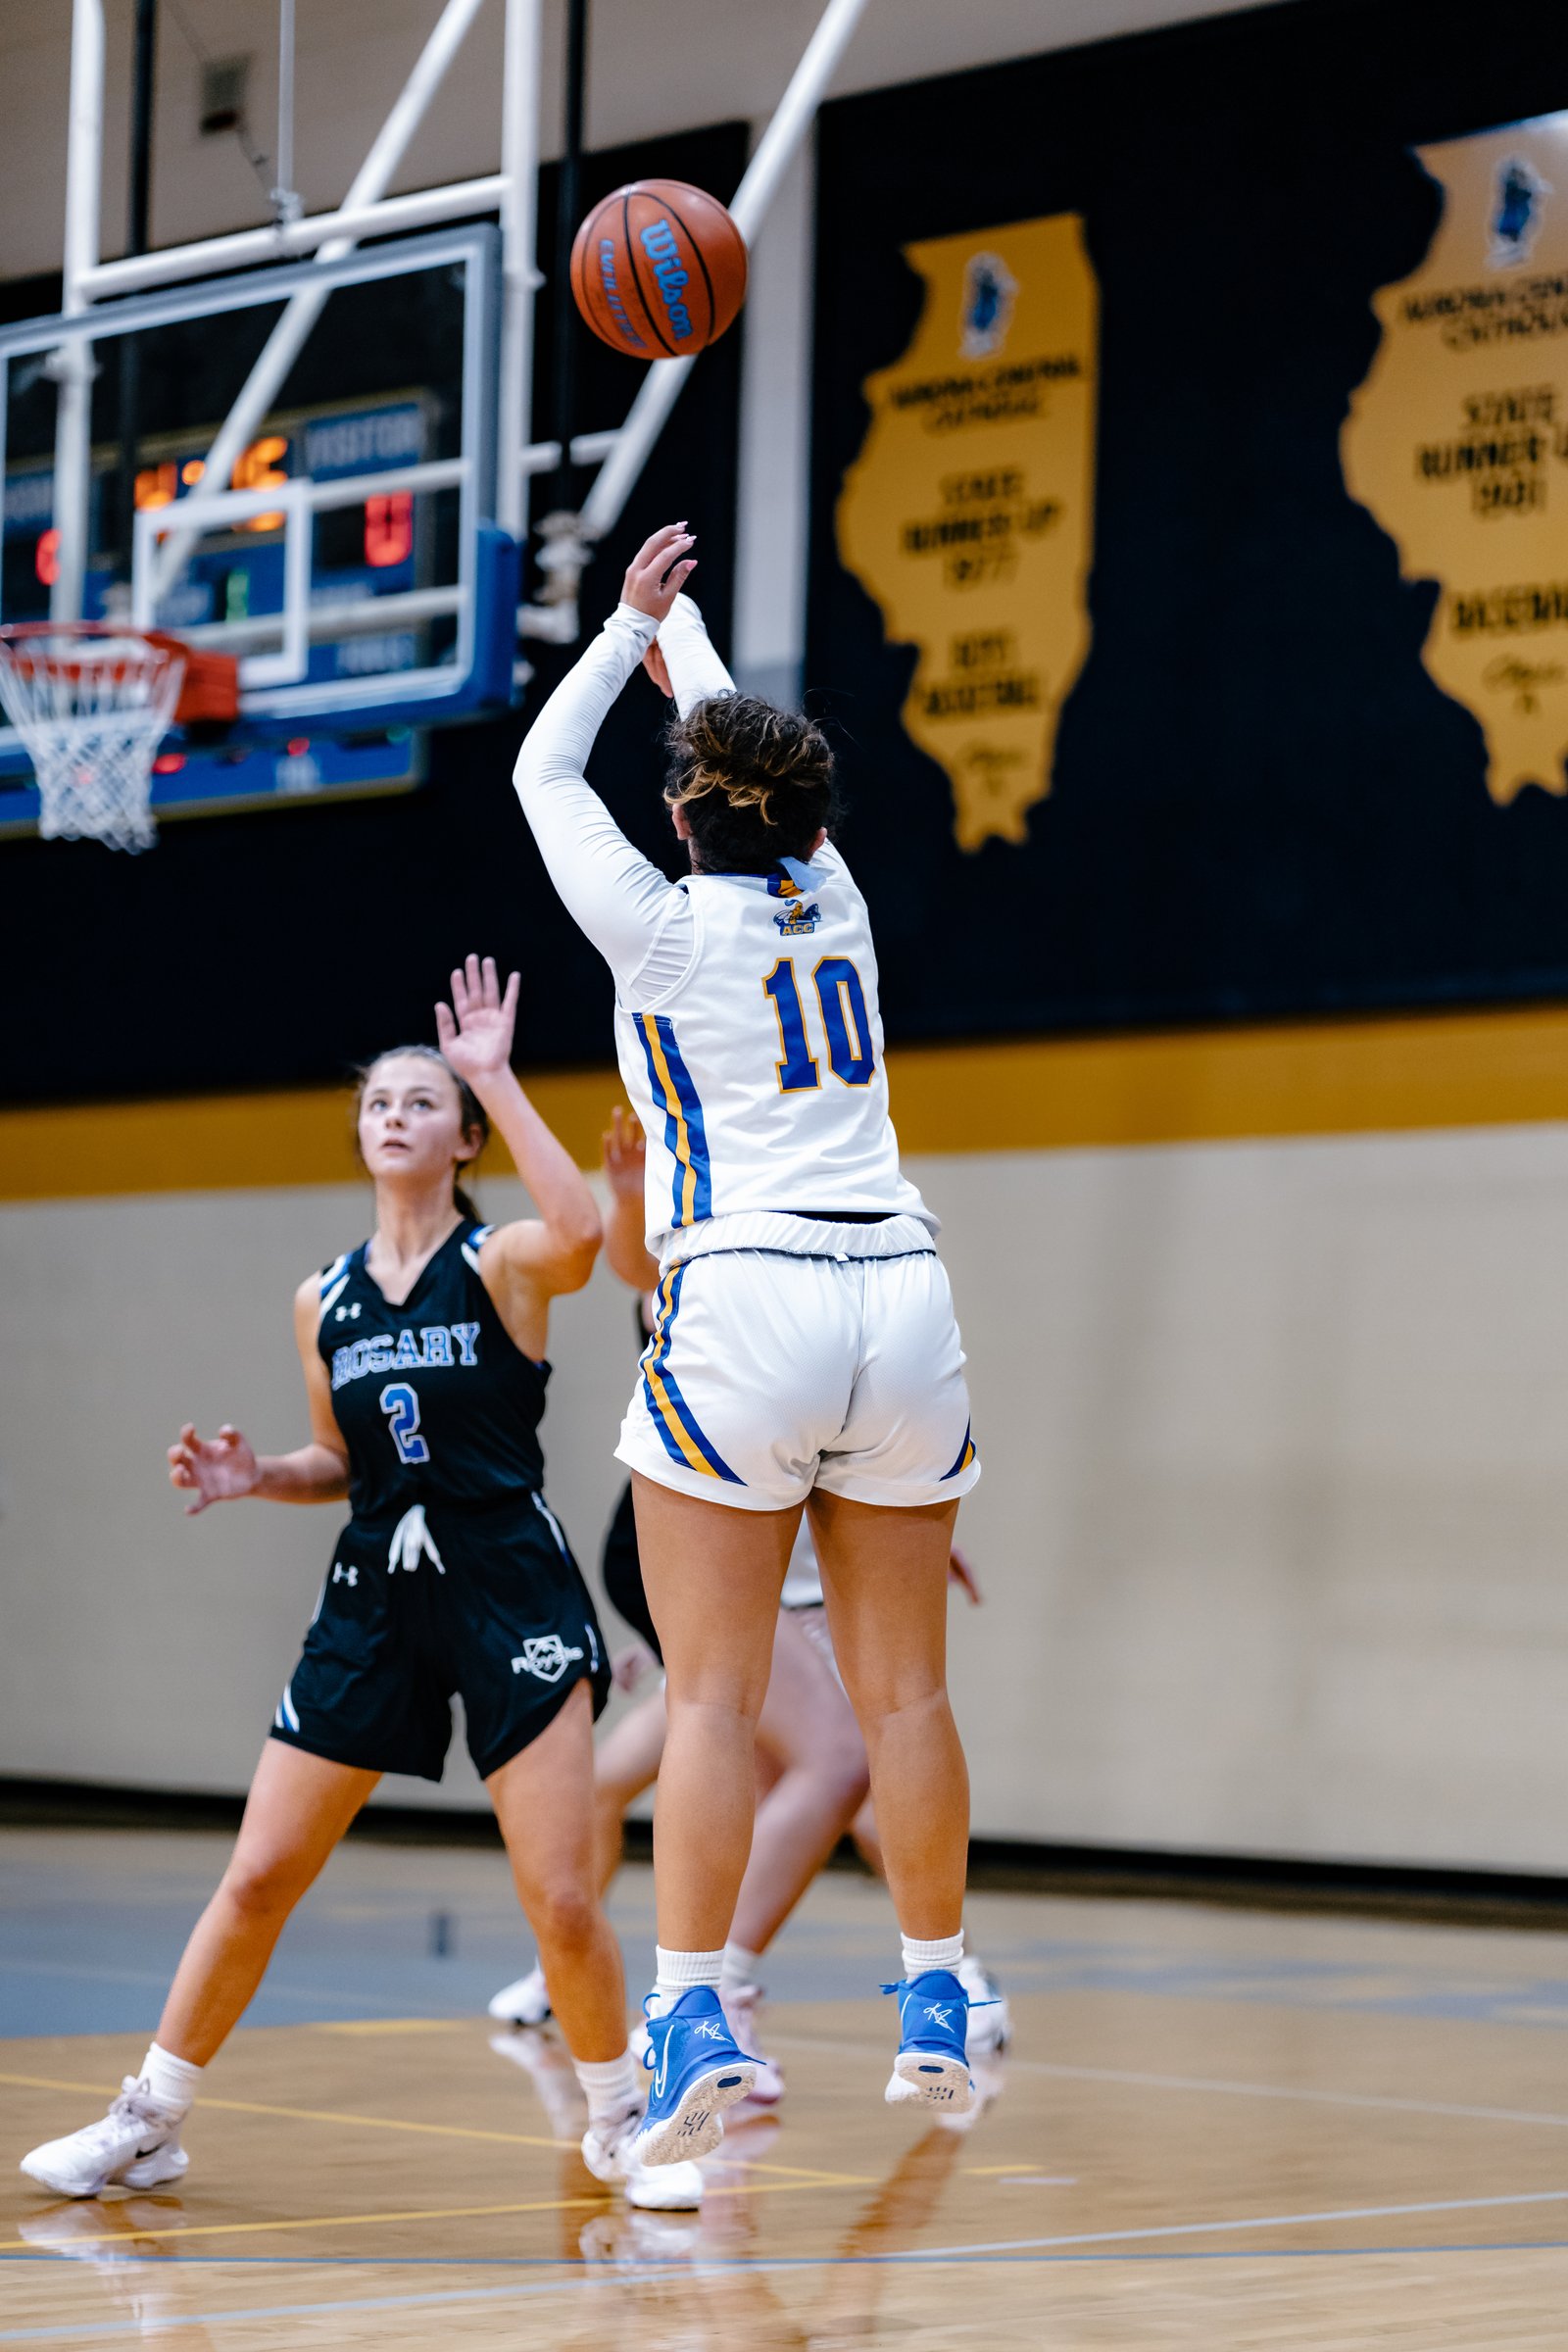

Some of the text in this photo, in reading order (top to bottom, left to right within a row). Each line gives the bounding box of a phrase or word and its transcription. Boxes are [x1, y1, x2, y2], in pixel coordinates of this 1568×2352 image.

[641, 220, 694, 340] Wilson
[782, 922, 814, 936] ACC
[761, 956, 876, 1094] 10
[332, 1321, 480, 1391] ROSARY
[379, 1383, 430, 1464] 2
